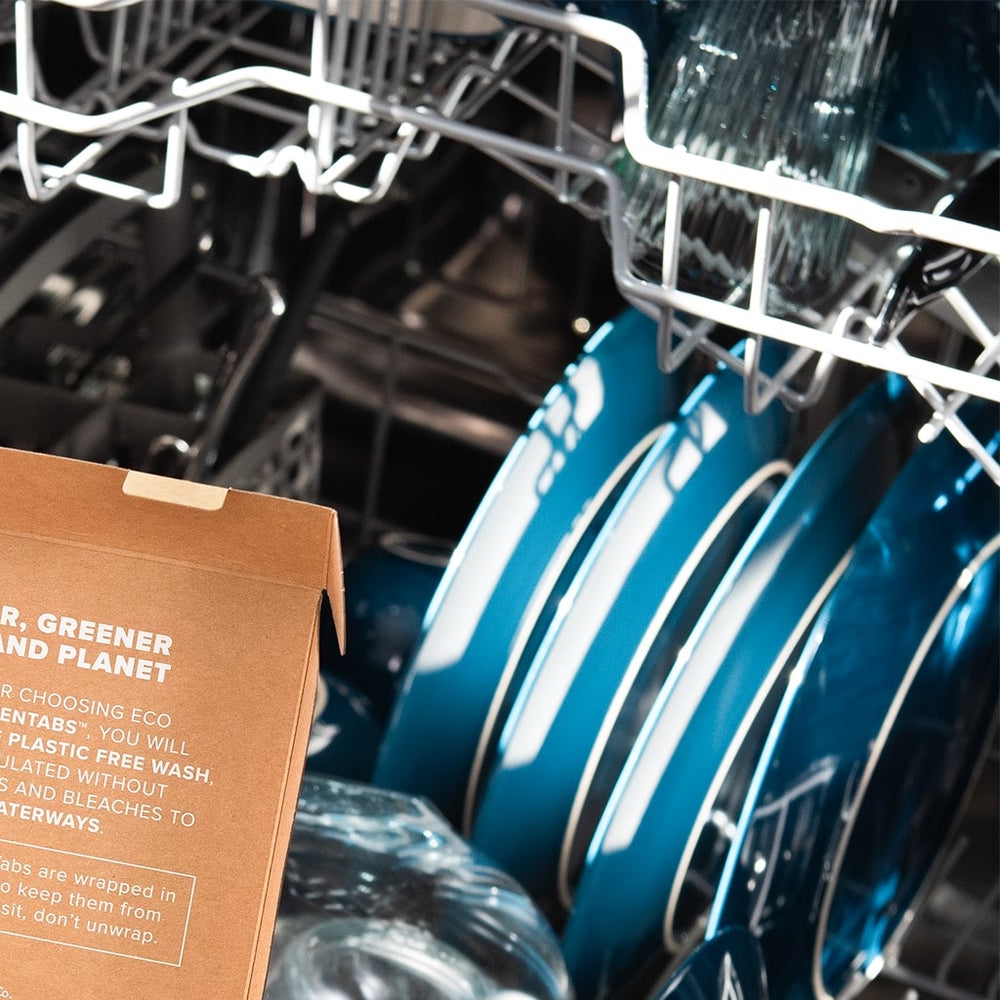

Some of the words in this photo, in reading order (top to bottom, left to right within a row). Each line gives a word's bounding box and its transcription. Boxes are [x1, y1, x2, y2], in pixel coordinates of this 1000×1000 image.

[37, 612, 173, 656] GREENER
[57, 644, 172, 683] PLANET
[19, 687, 125, 720] CHOOSING
[131, 707, 172, 729] ECO
[7, 732, 90, 761] PLASTIC
[95, 748, 145, 771] FREE
[151, 758, 214, 787] WASH,
[99, 725, 140, 746] YOU
[147, 734, 190, 756] WILL
[77, 768, 169, 799] WITHOUT
[14, 781, 56, 801] AND
[62, 789, 163, 822] BLEACHES
[170, 809, 196, 827] TO
[17, 882, 62, 906] keep
[69, 892, 114, 913] them
[120, 901, 161, 923] from
[38, 867, 68, 882] are
[74, 873, 154, 899] wrapped
[160, 886, 176, 903] in
[86, 920, 157, 945] unwrap.
